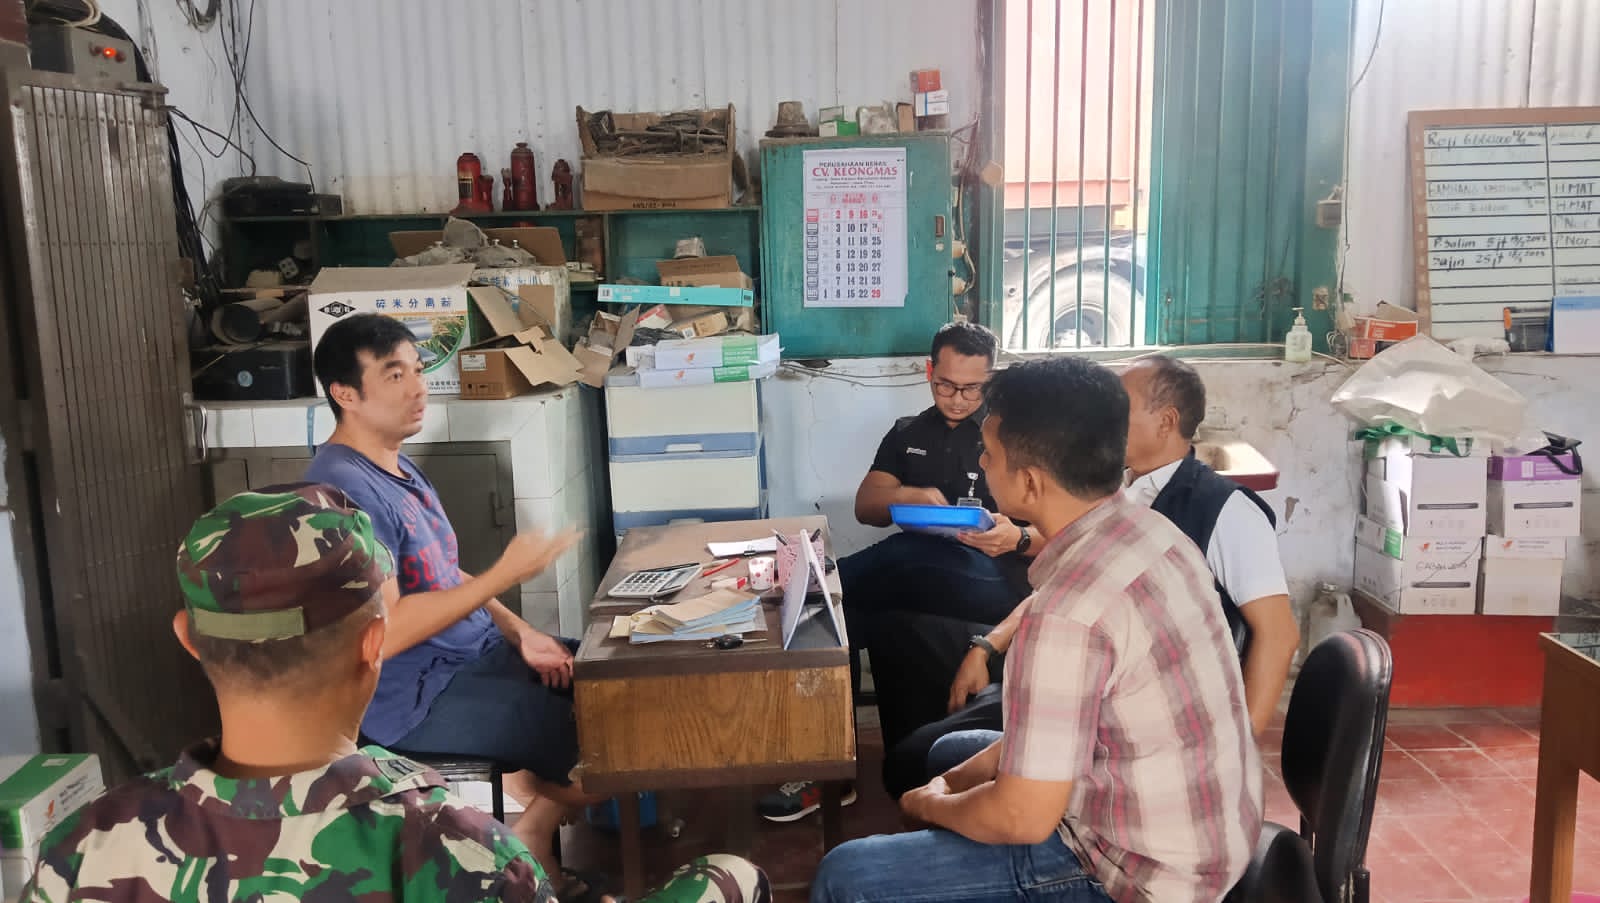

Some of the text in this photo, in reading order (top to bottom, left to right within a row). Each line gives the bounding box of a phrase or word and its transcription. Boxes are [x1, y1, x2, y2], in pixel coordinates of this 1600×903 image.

[812, 166, 898, 177] CV. KEONGMAS
[836, 224, 841, 232] 3
[848, 224, 856, 232] 10
[860, 224, 868, 232] 17
[836, 236, 882, 246] 4 11 18 25
[836, 250, 882, 259] 5 12 19 26
[836, 263, 882, 272] 6 13 20 27
[836, 276, 841, 286] 7
[848, 276, 856, 286] 14
[860, 276, 868, 286] 21
[848, 290, 856, 298] 15
[860, 290, 868, 298] 22
